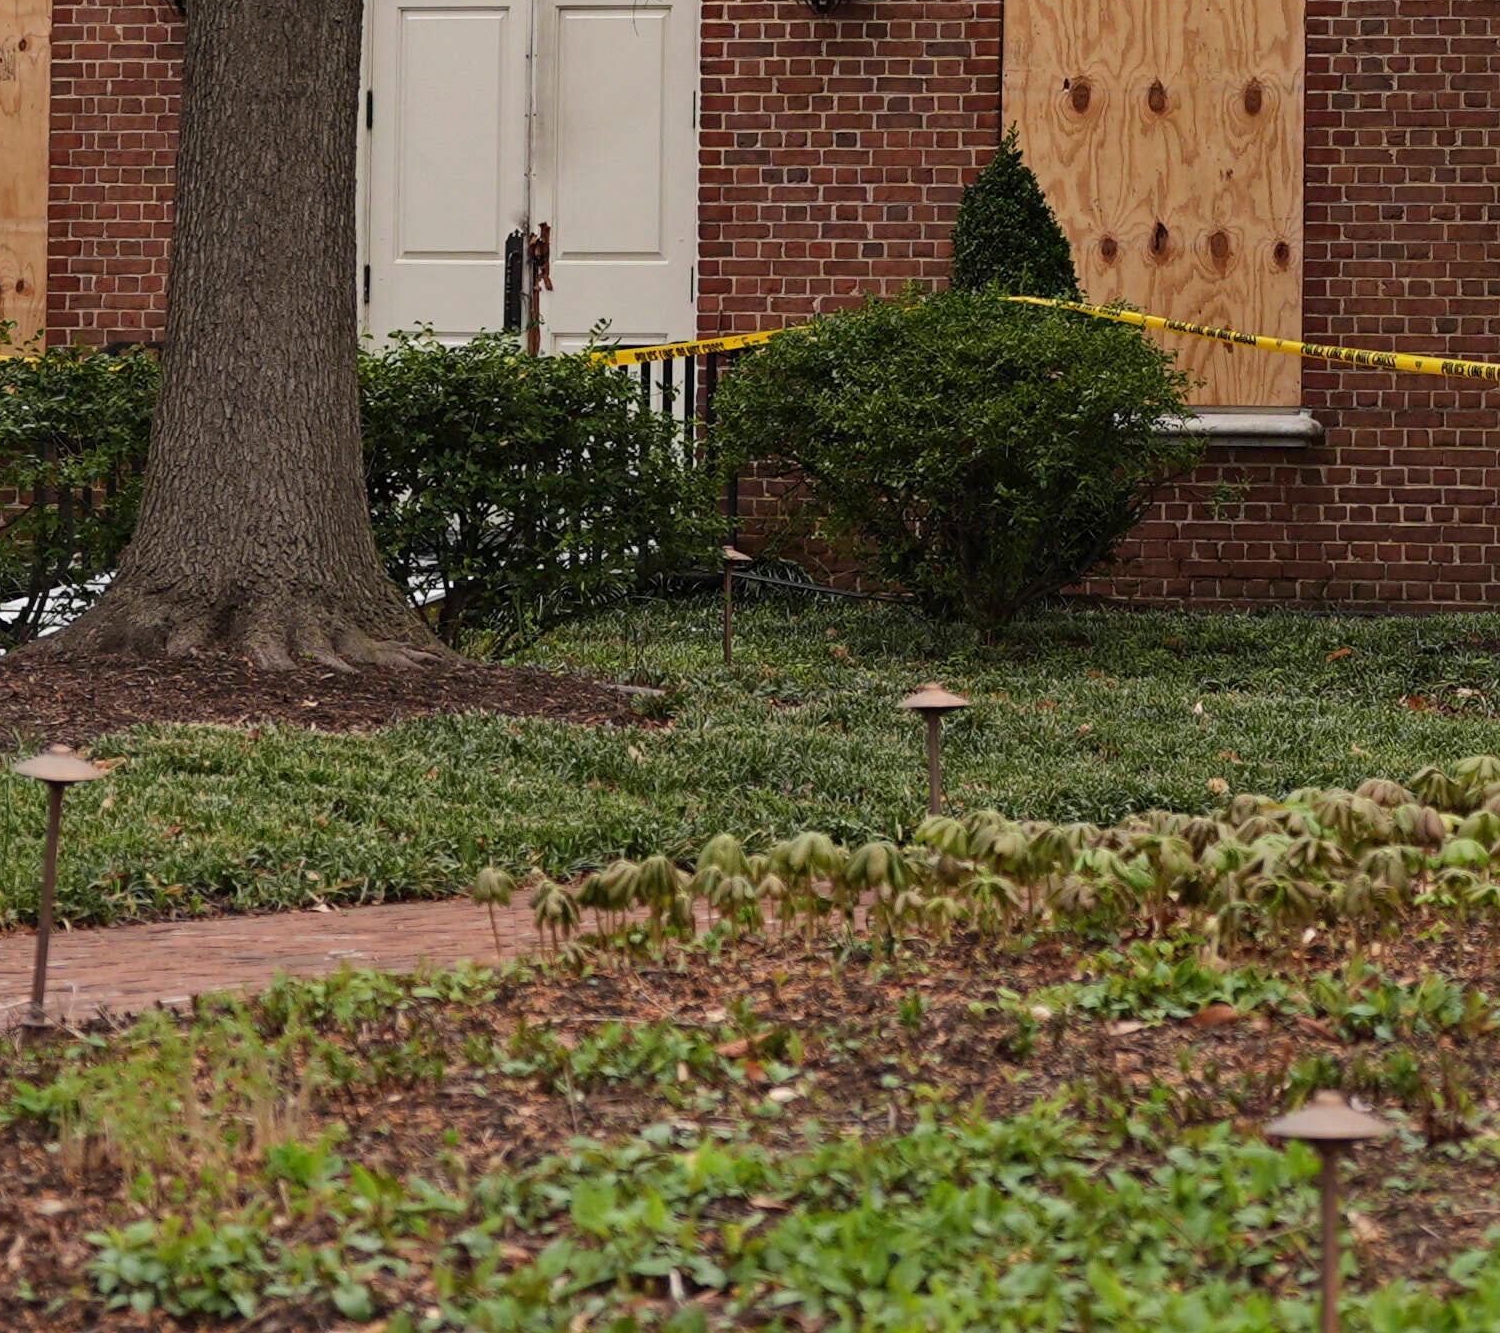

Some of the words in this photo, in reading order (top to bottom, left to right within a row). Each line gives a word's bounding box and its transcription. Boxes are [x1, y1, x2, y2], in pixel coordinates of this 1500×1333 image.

[634, 350, 658, 362] POLICE
[659, 349, 675, 360] LINE
[702, 342, 724, 354] CROSS
[1301, 343, 1323, 357] POLICE
[1326, 347, 1342, 360] LINE
[1355, 350, 1369, 365] NOT
[1372, 352, 1396, 367] CROSS
[1442, 361, 1465, 375] POLICE
[1468, 364, 1482, 378] LINE
[1485, 366, 1495, 380] DO
